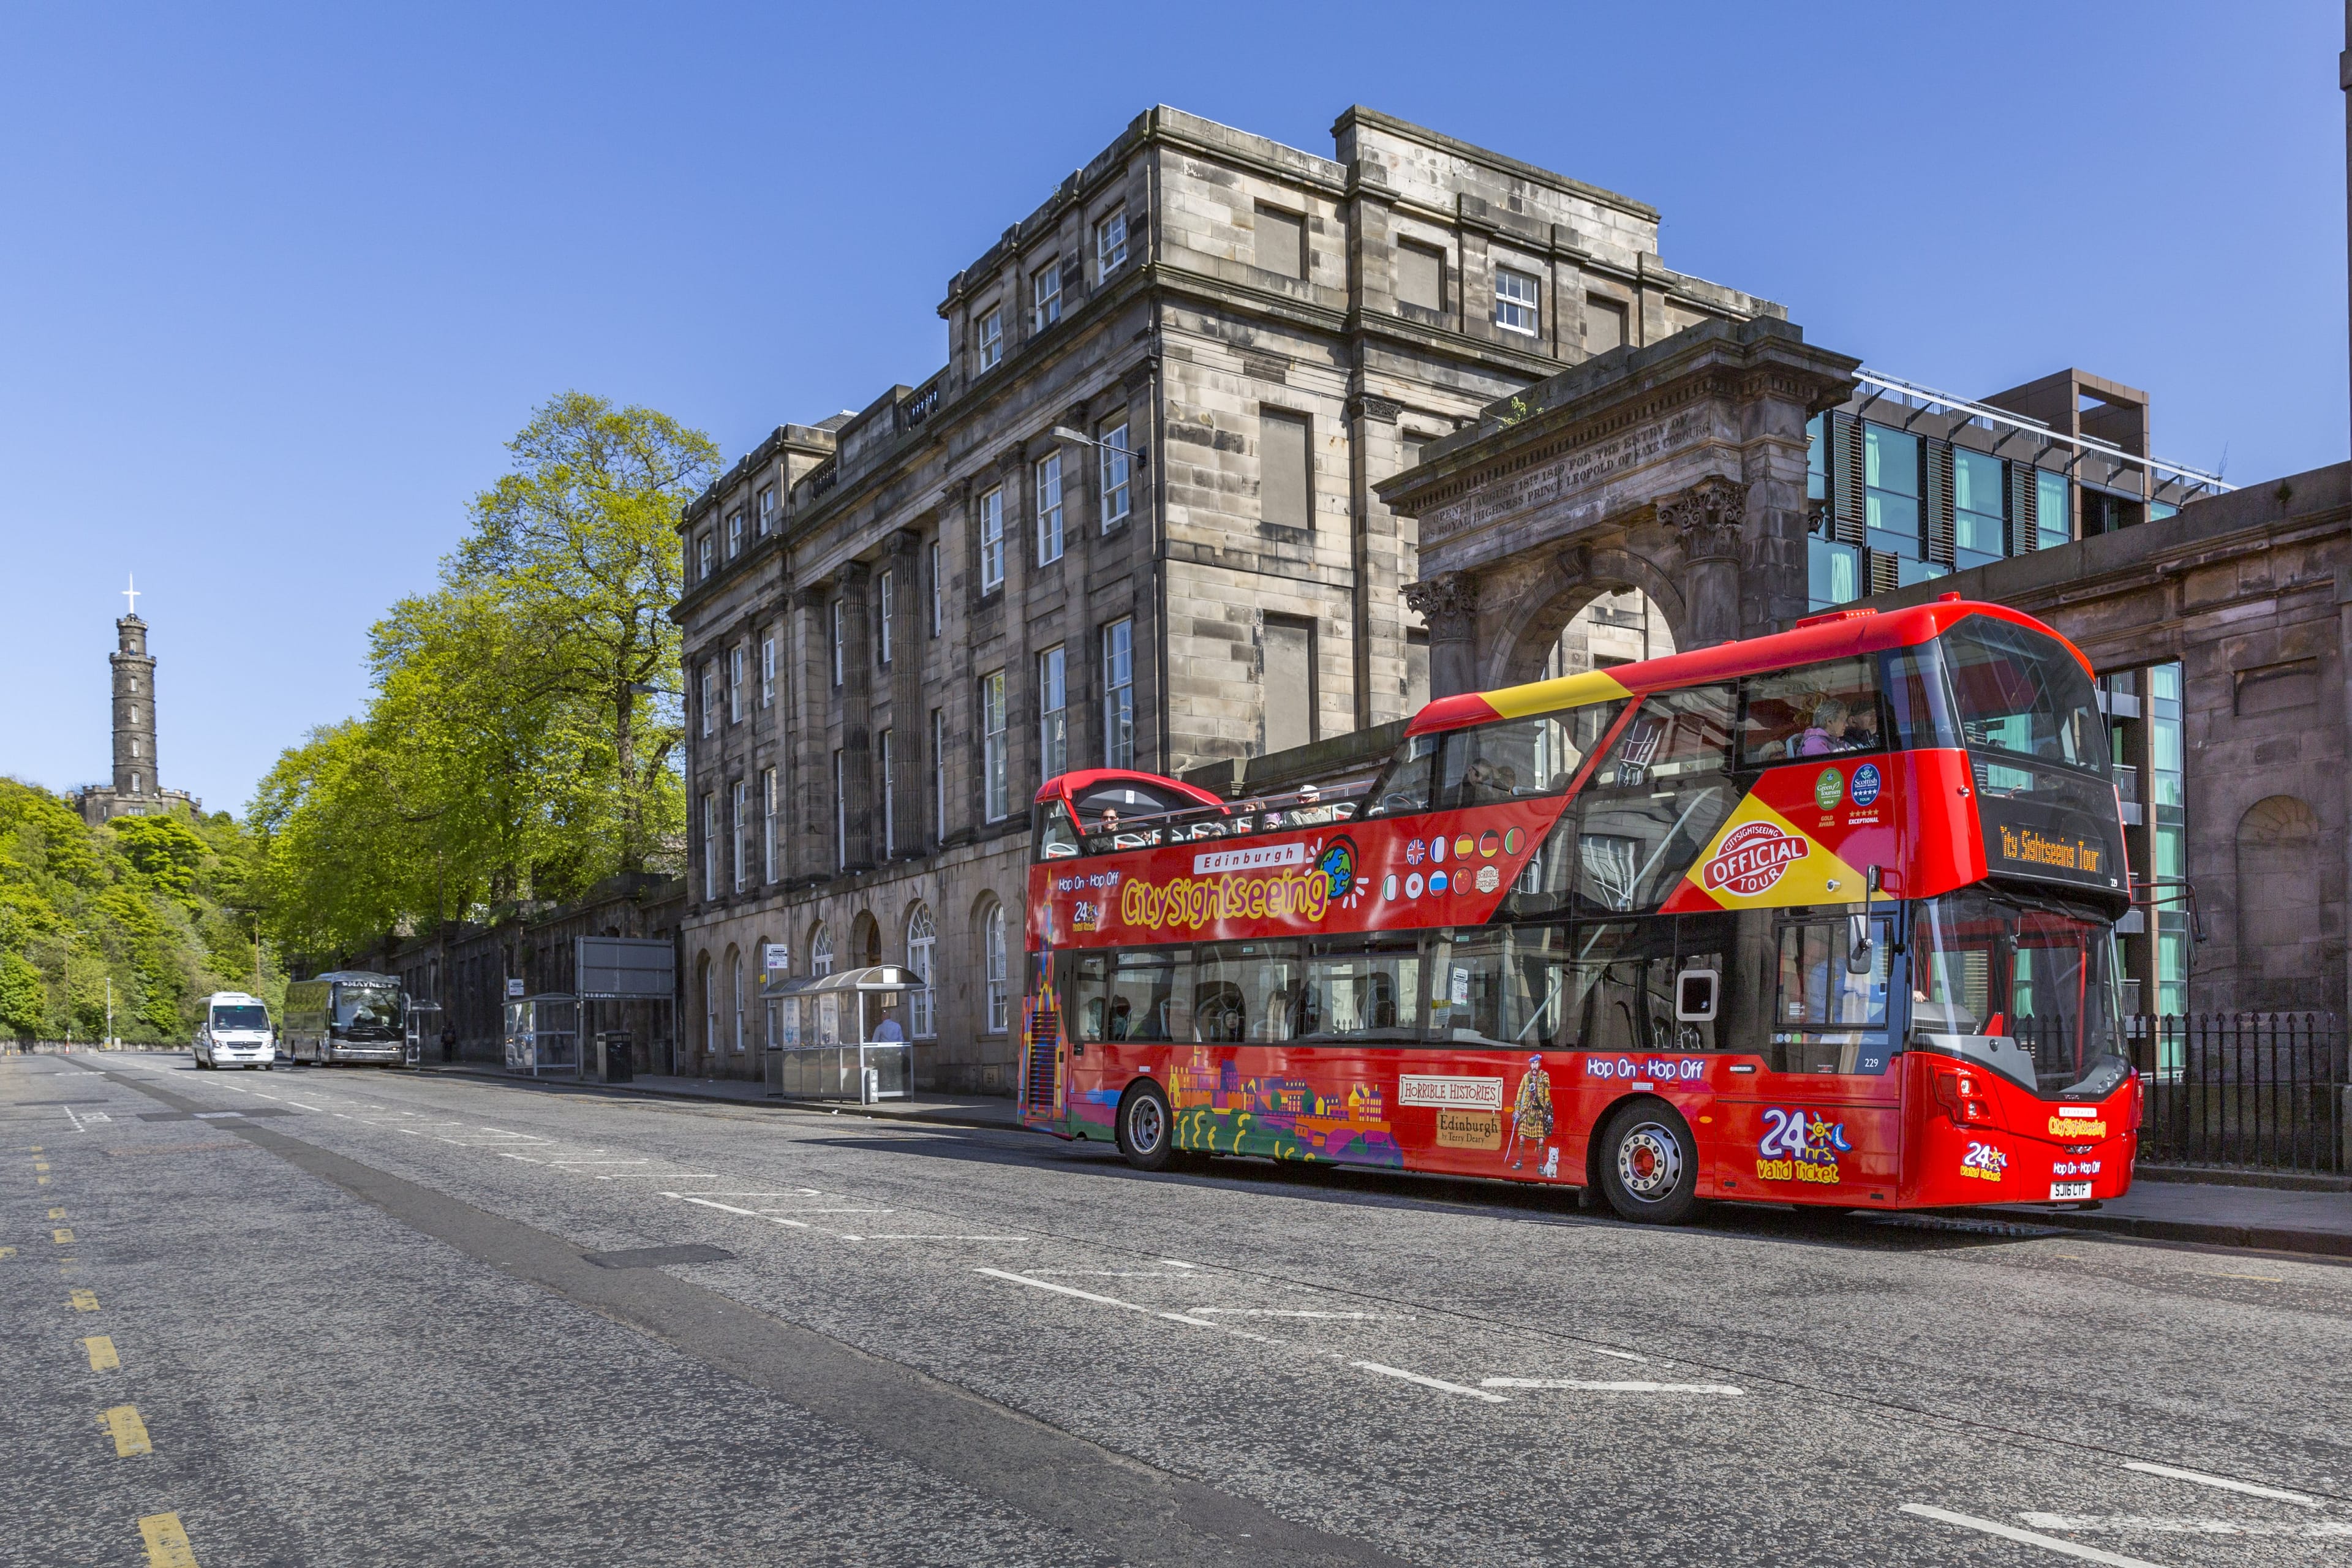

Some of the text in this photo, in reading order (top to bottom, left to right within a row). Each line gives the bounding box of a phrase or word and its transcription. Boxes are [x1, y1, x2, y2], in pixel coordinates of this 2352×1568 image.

[1475, 483, 1515, 508] AUGUST
[1569, 453, 1592, 471] FOR
[1596, 442, 1619, 459] THE
[1473, 495, 1523, 523] HIGHNESS
[1528, 480, 1562, 502] PRINCE
[1567, 461, 1613, 486] LEOPOLD
[1618, 453, 1631, 465] OF
[1725, 826, 1779, 851] CITYSIGHTSEEING
[1204, 847, 1293, 868] Edinburgh
[1713, 840, 1803, 882] OFFICIAL
[2078, 840, 2099, 872] Tour
[1058, 872, 1119, 892] Hop On Hop Off
[1741, 868, 1780, 891] TOUR
[1121, 868, 1329, 930] CitySightseeing
[1074, 901, 1087, 922] 24
[1588, 1058, 1613, 1079] Hop
[1618, 1058, 1636, 1077] On
[1648, 1060, 1676, 1080] Hop
[1681, 1060, 1704, 1079] Off
[1864, 1058, 1879, 1068] 229
[1405, 1082, 1496, 1101] HORRIBLE HISTORIES
[1440, 1115, 1498, 1137] Edinburgh
[1760, 1109, 1806, 1157] 24
[1448, 1132, 1464, 1145] Terry
[1466, 1134, 1485, 1146] Deary
[1964, 1142, 1991, 1168] 24
[1757, 1159, 1840, 1183] Valid Ticket
[1960, 1165, 2001, 1182] Valid Ticket
[2053, 1161, 2101, 1175] Hop On Hop Off
[2055, 1183, 2087, 1196] SJ16 CTF
